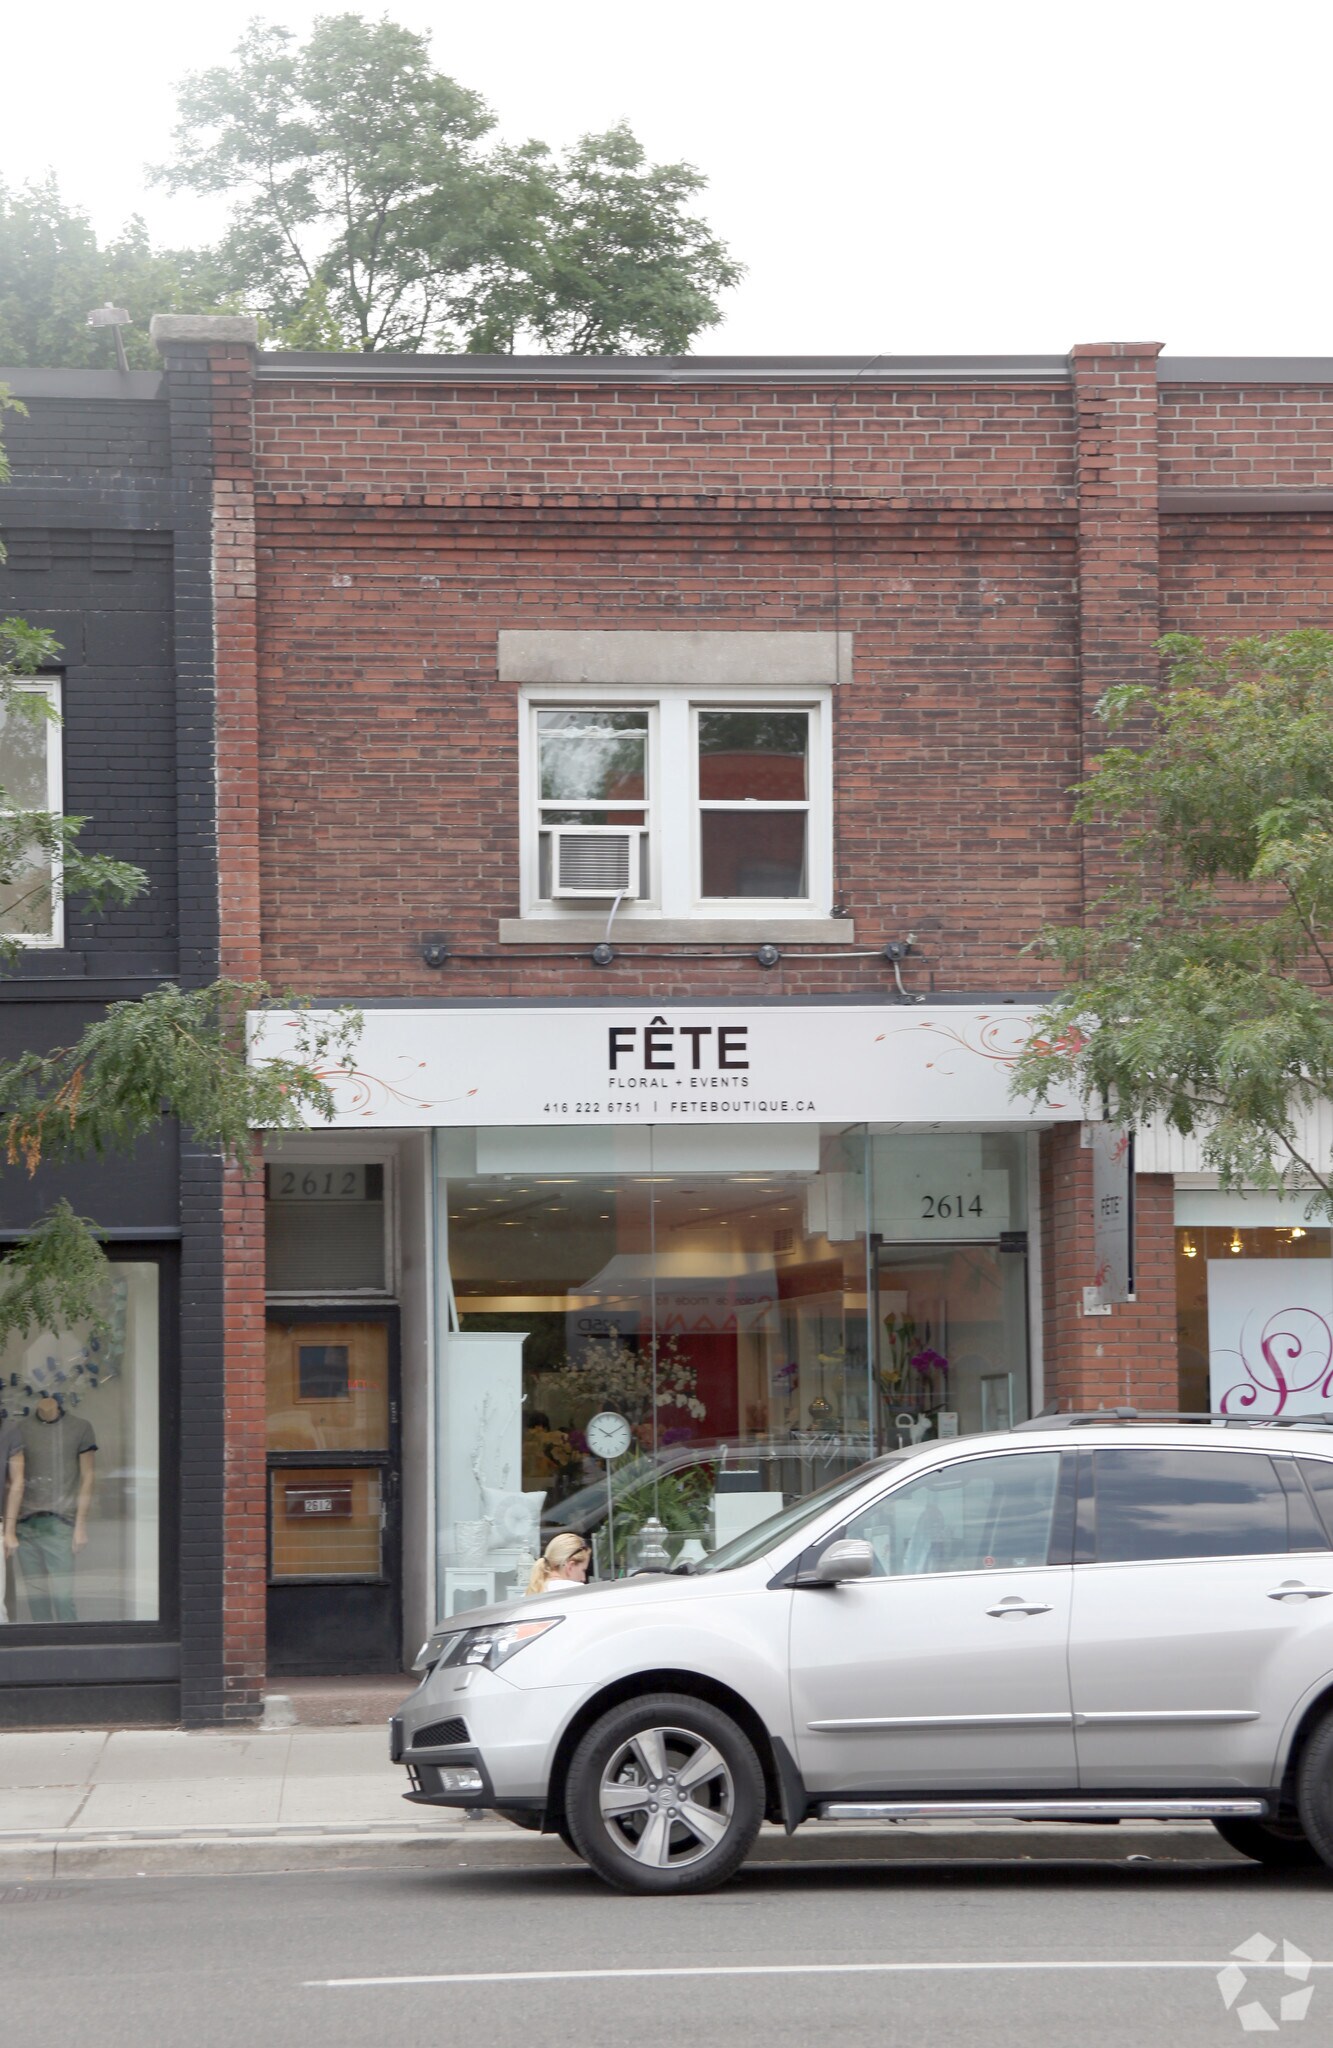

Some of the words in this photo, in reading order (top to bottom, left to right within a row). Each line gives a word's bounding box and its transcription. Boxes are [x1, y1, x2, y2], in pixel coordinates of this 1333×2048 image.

[608, 1015, 750, 1070] FÊTE
[608, 1077, 668, 1088] FLORAL
[690, 1076, 750, 1088] EVENTS
[543, 1102, 569, 1113] 416
[575, 1102, 601, 1113] 222
[607, 1102, 641, 1113] 6751
[670, 1100, 817, 1113] FETEBOUTIQUE.CA
[280, 1171, 357, 1196] 2612
[921, 1194, 984, 1219] 2614
[306, 1499, 332, 1511] 2612
